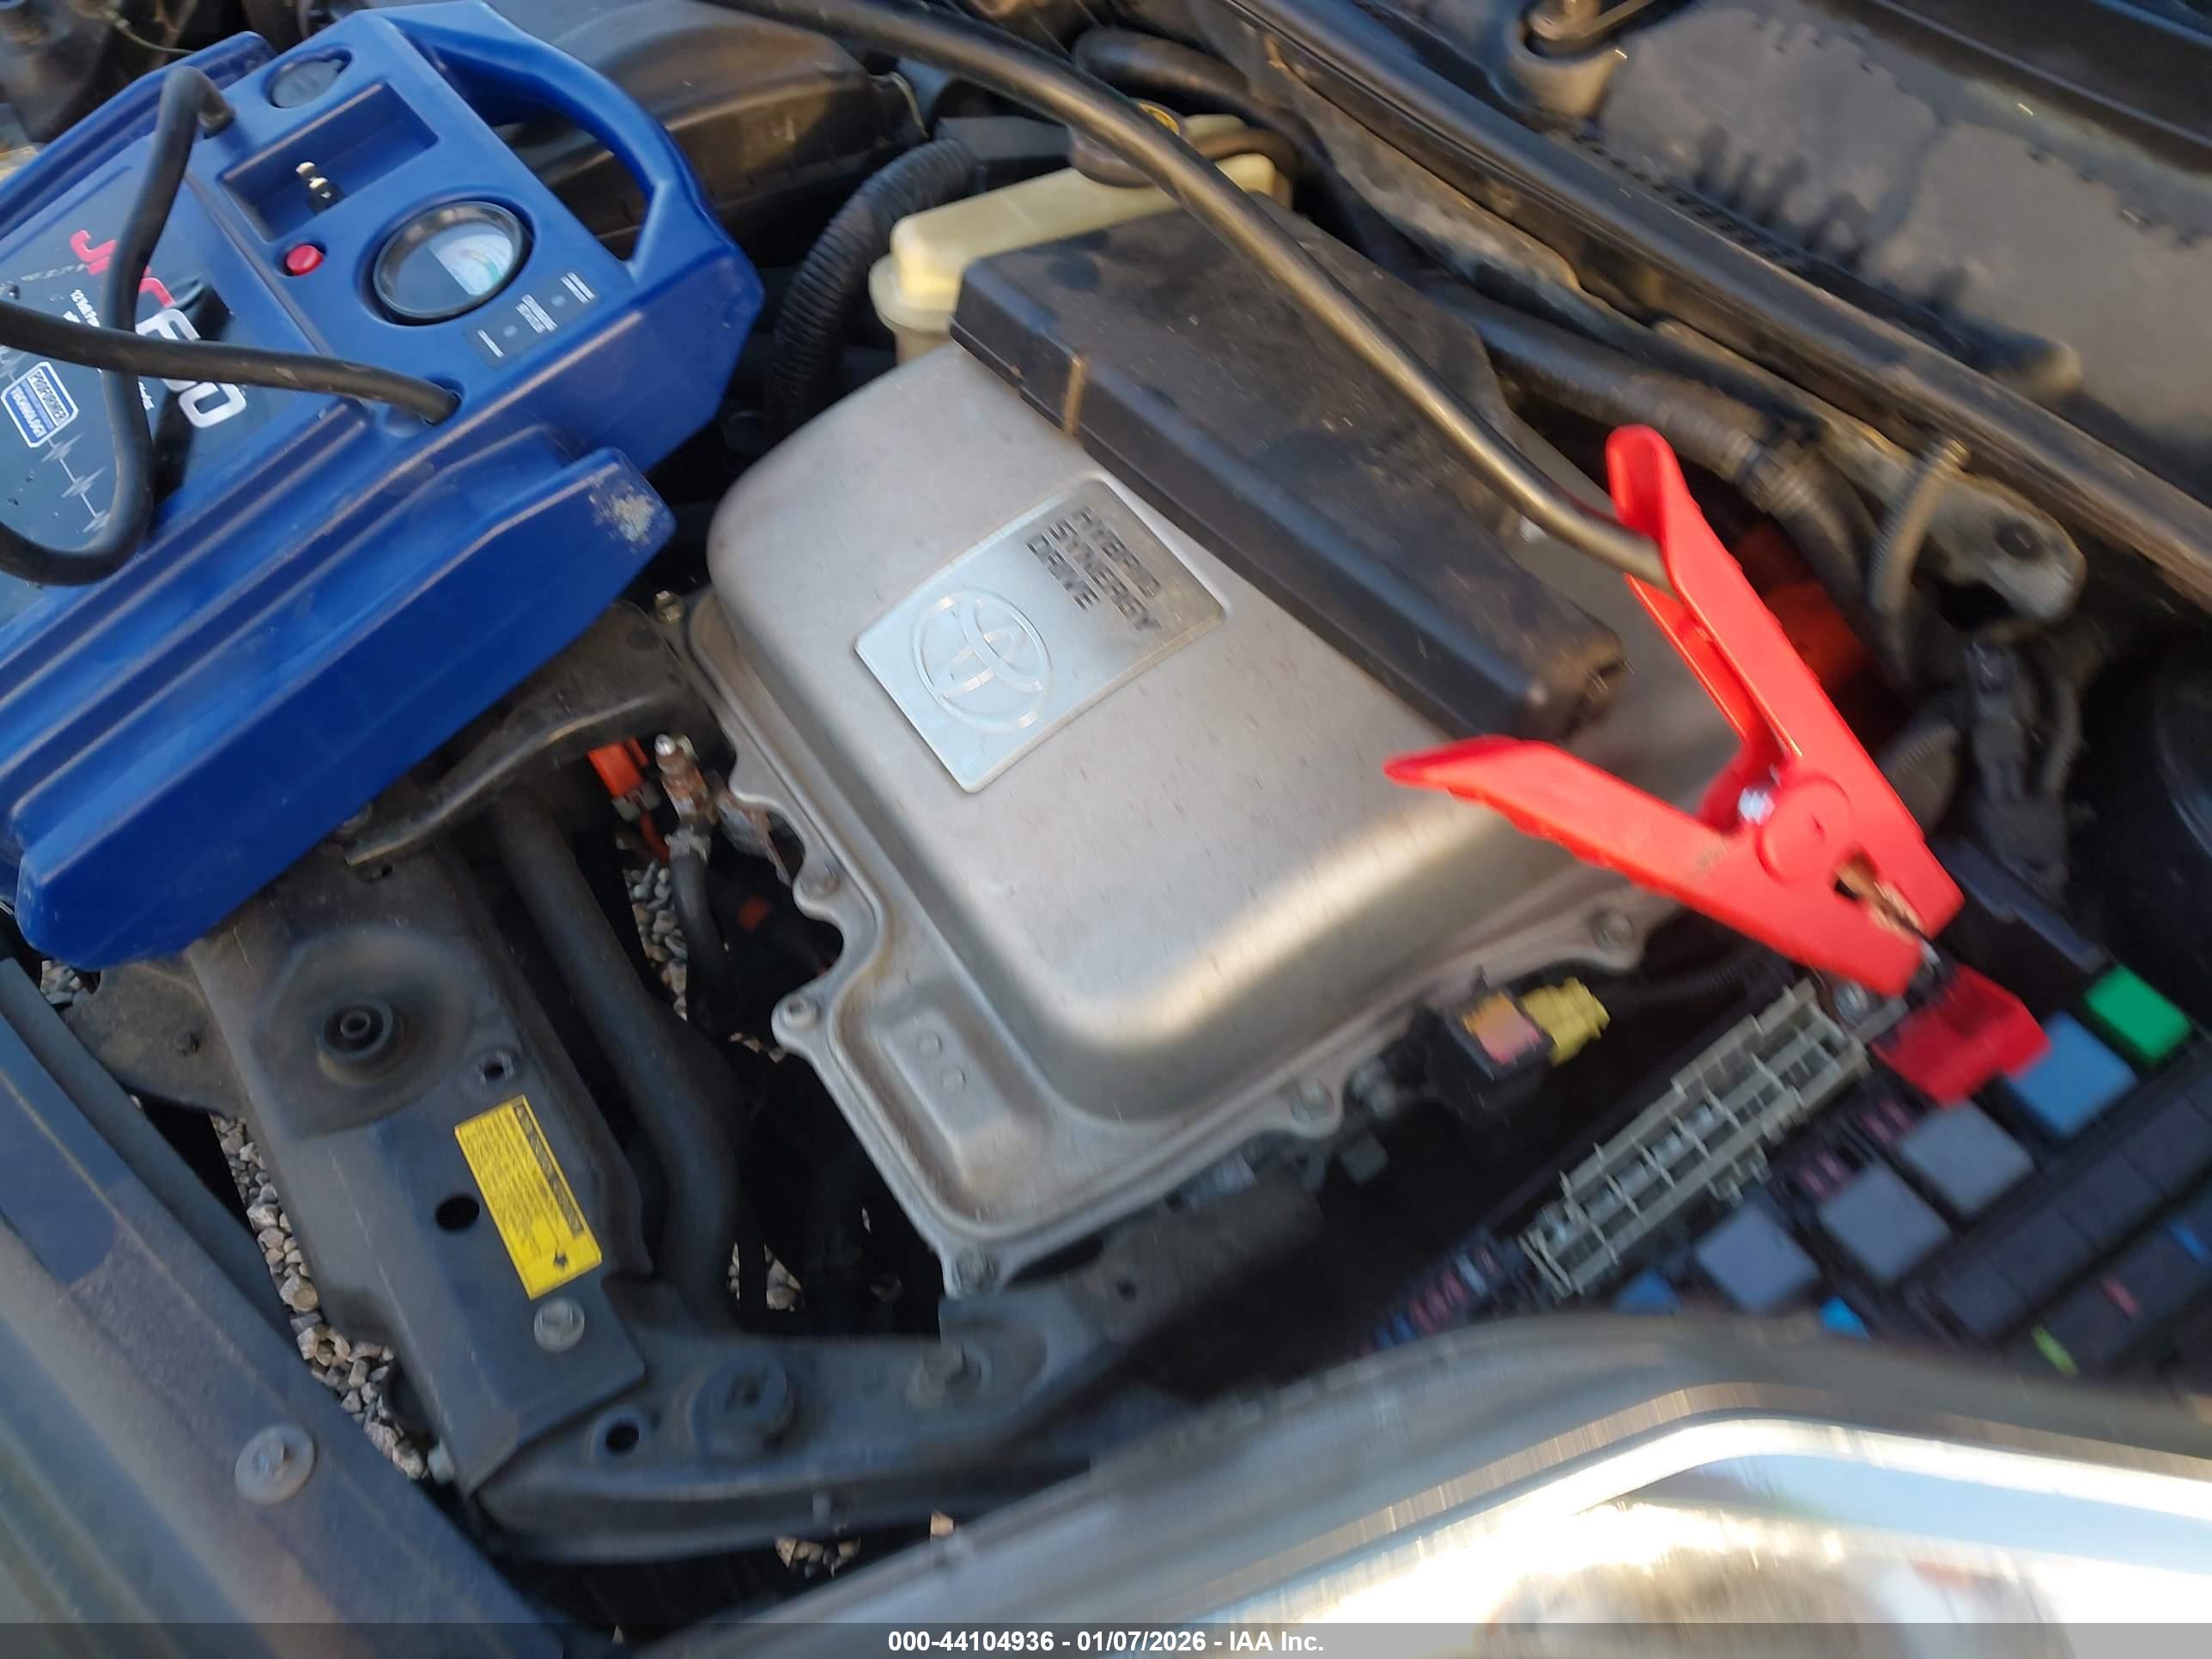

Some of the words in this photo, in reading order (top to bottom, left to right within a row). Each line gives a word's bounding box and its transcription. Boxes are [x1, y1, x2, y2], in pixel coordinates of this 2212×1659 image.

[1024, 532, 1100, 612] DRIVE
[1047, 519, 1163, 632] SYNERGY
[1072, 505, 1163, 599] HYBRID
